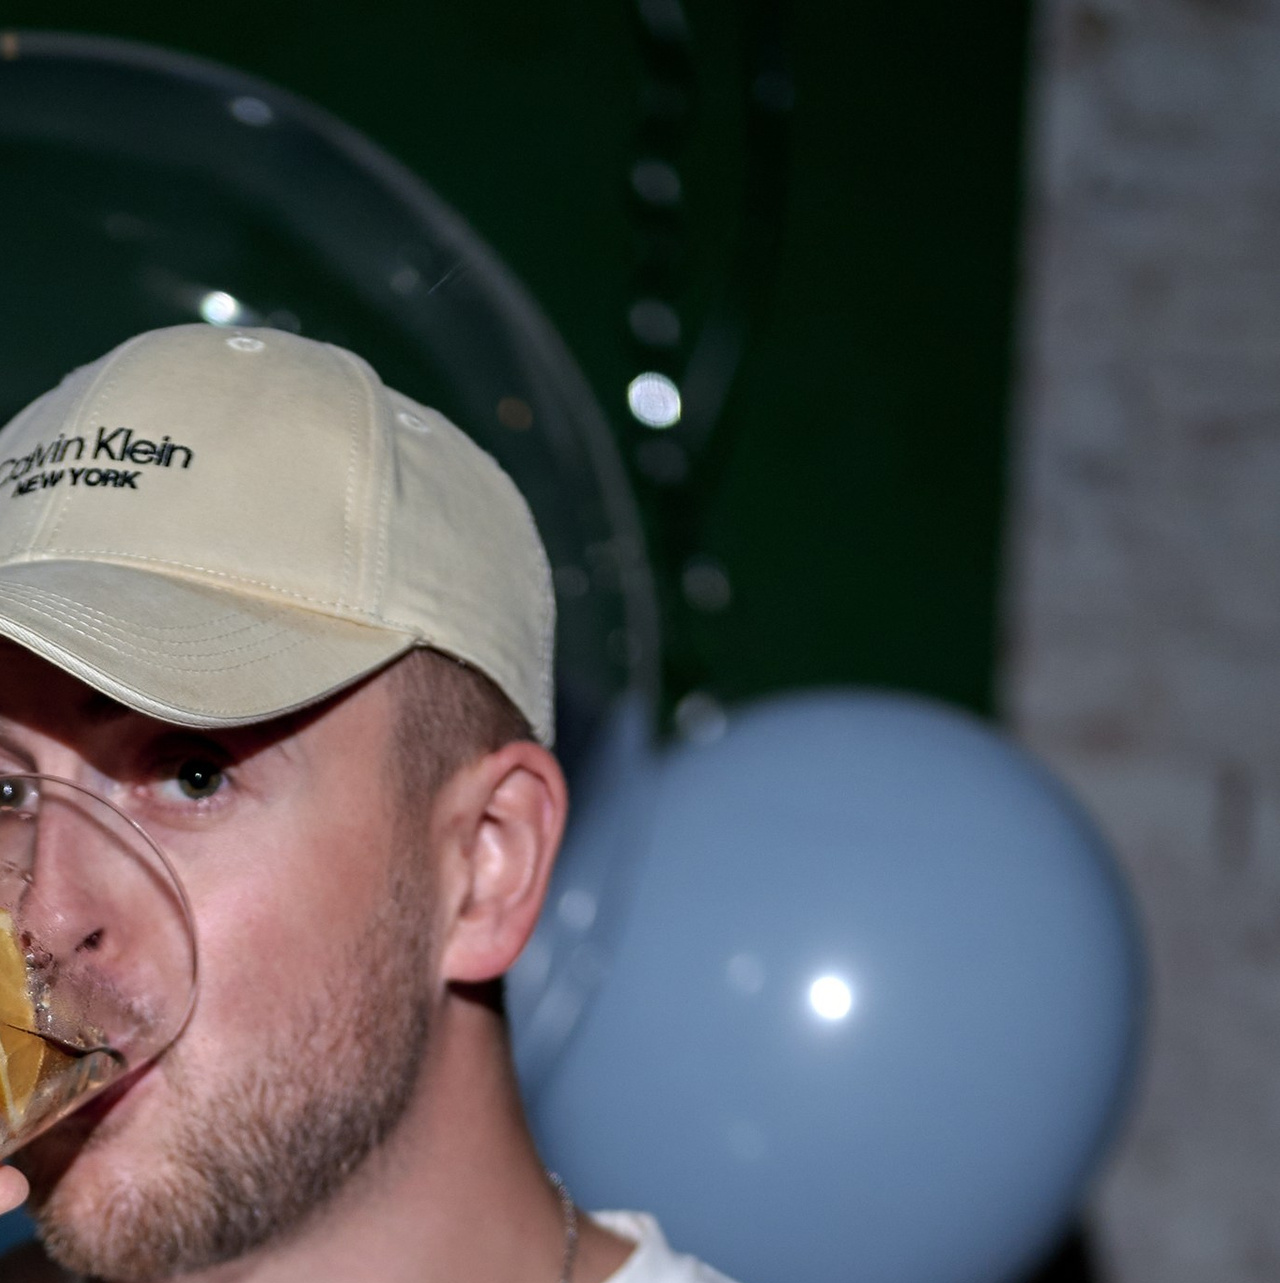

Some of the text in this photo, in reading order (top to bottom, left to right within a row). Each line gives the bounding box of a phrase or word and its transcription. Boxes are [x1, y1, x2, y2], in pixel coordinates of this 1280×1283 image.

[92, 426, 193, 468] Klein
[11, 467, 142, 497] NEW YORK
